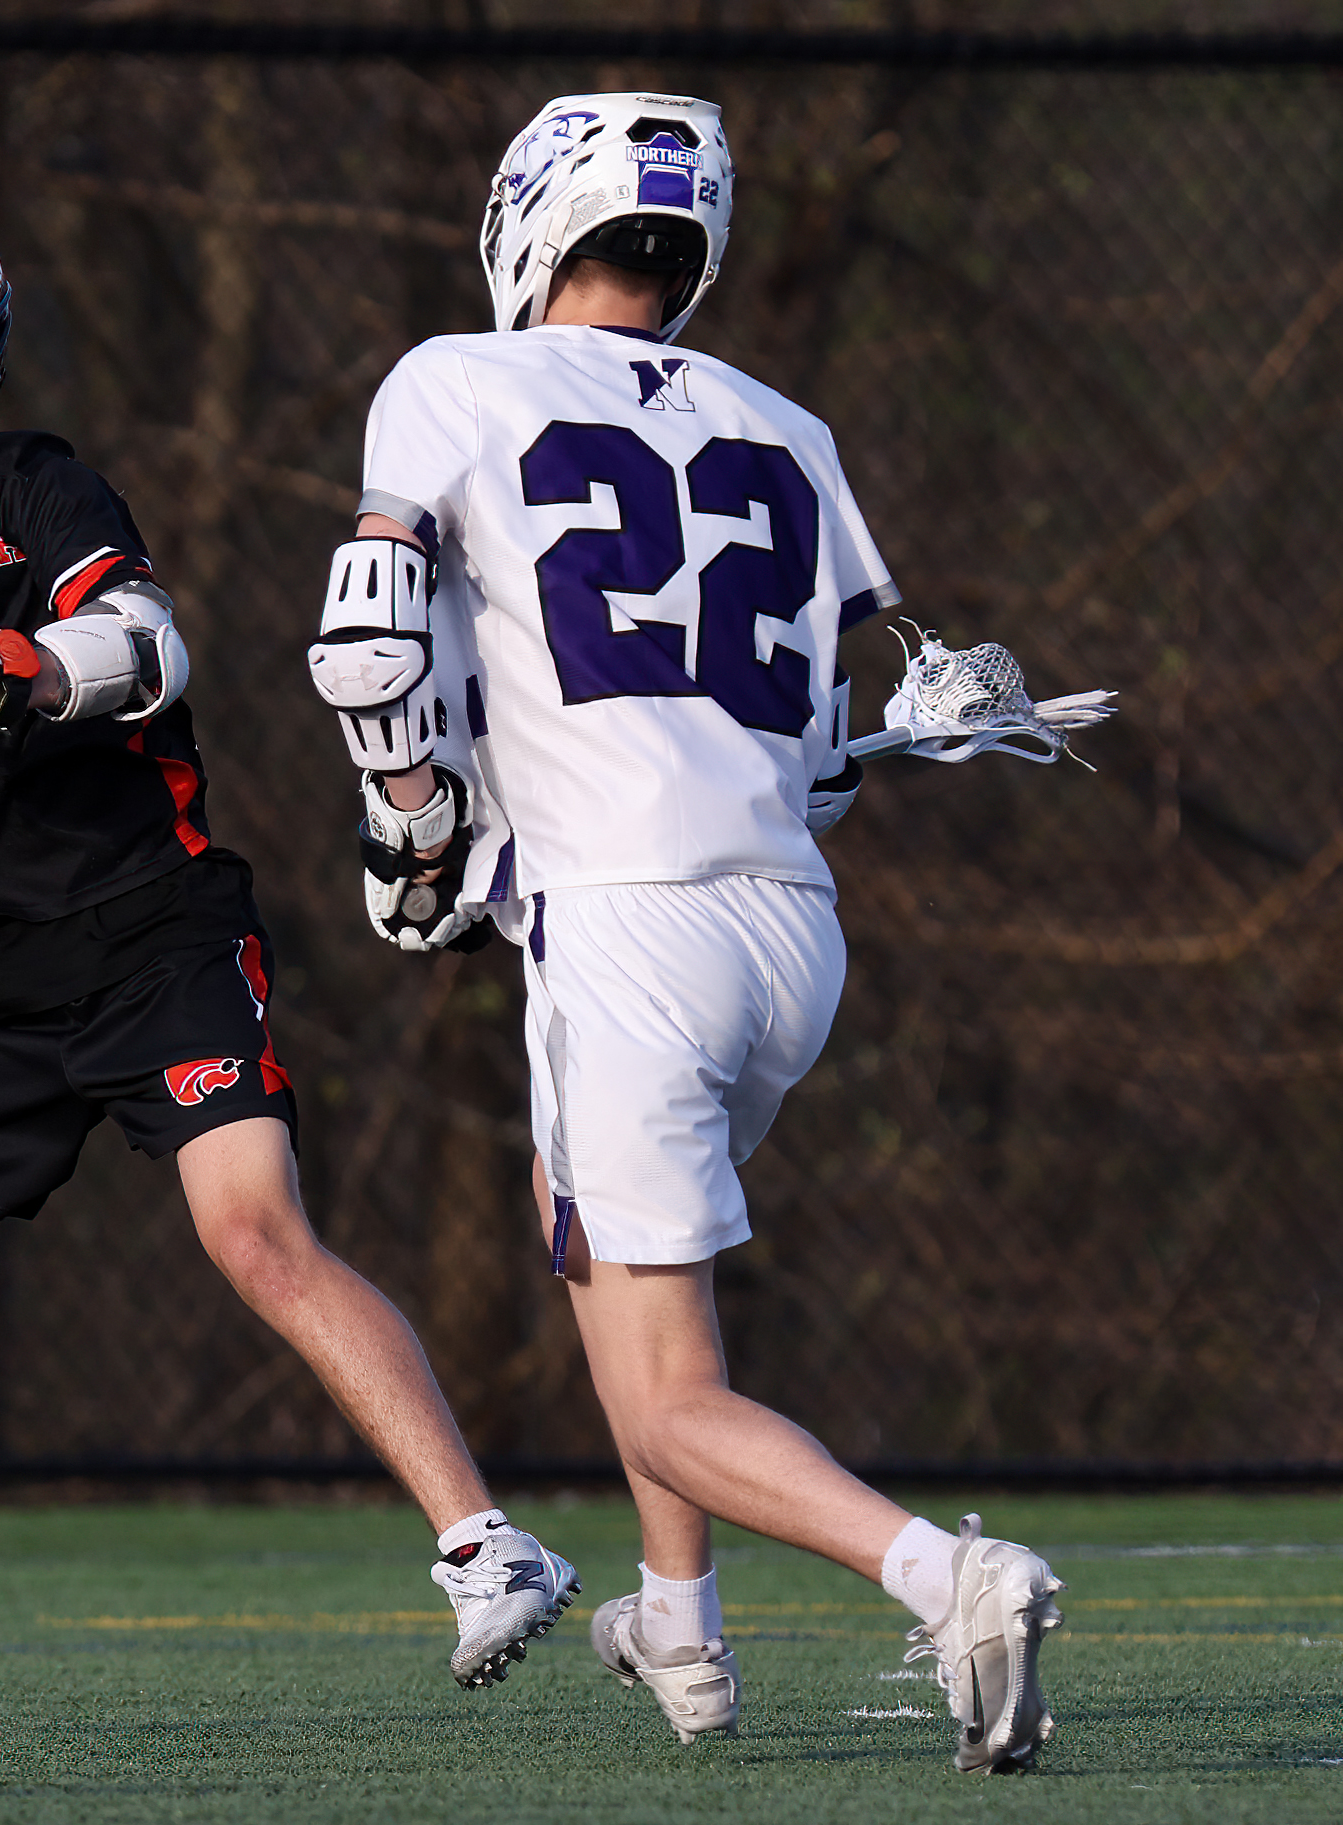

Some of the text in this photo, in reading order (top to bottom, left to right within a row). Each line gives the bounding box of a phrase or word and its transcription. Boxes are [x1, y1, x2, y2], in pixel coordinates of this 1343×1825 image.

[636, 96, 695, 107] cascade
[626, 145, 704, 170] NORTHERN
[698, 176, 719, 209] 22
[629, 358, 696, 412] N
[519, 419, 819, 739] 22
